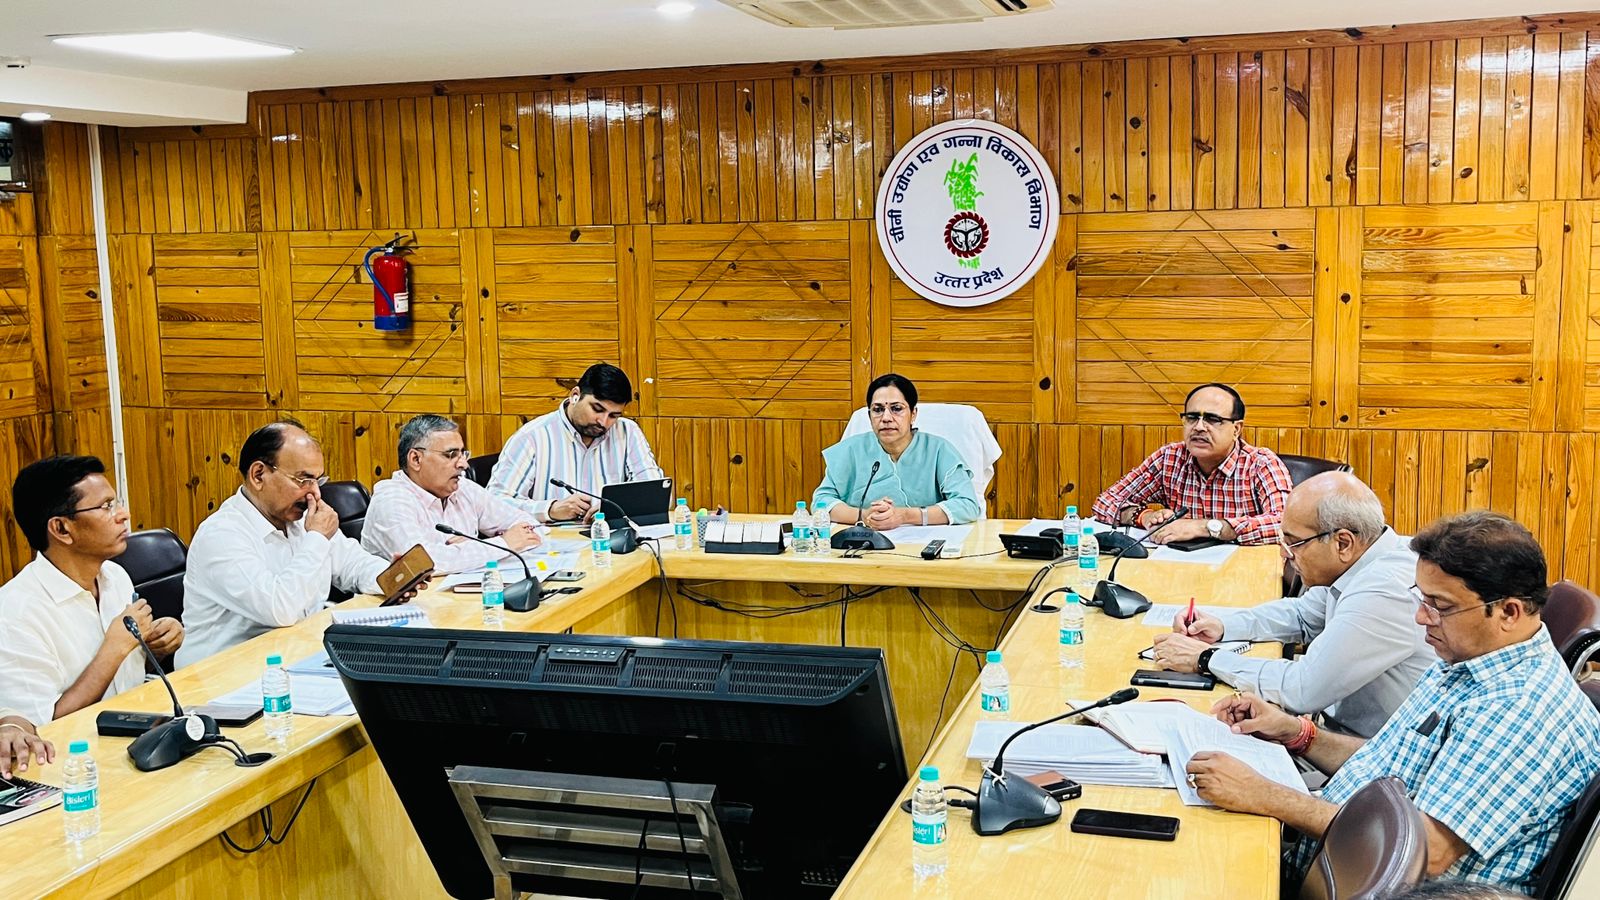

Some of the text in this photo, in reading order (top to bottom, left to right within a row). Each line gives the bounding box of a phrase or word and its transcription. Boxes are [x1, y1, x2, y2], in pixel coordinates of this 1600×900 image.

[942, 135, 984, 149] गन्ना
[986, 136, 1031, 178] विकास
[892, 162, 919, 204] उद्योग
[1025, 178, 1043, 230] विभाग
[887, 209, 905, 244] चीनी
[934, 267, 1004, 290] उत्तर प्रदेश
[66, 793, 91, 805] Bisleri
